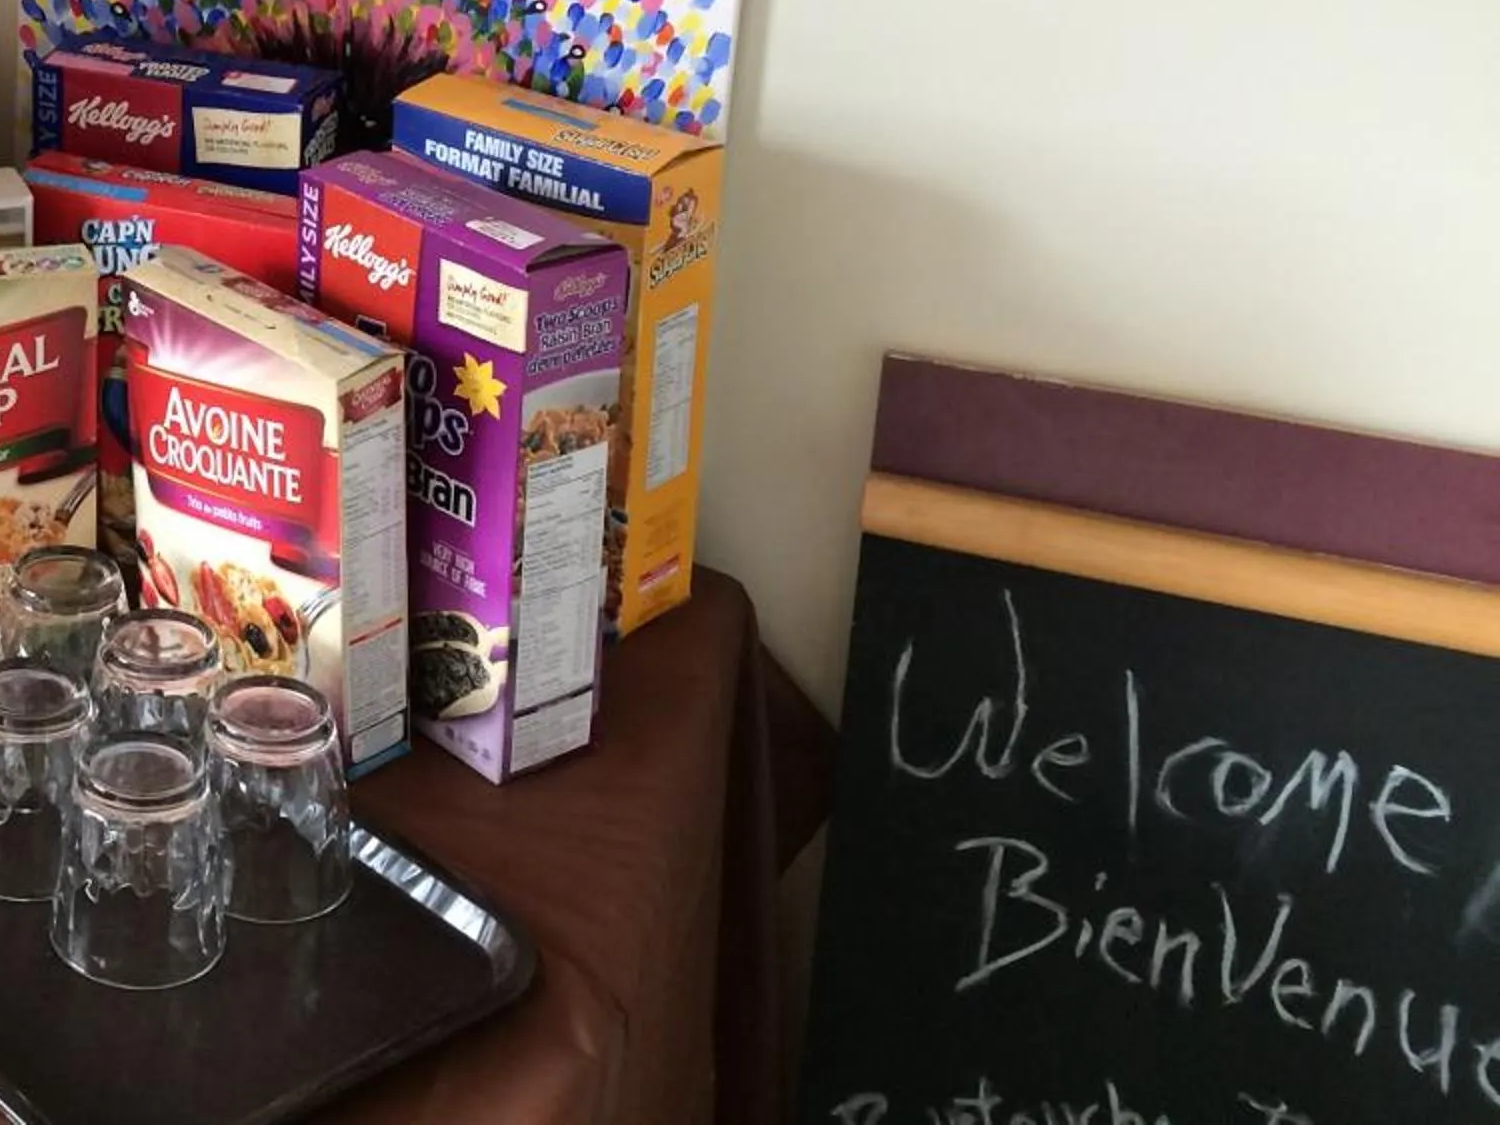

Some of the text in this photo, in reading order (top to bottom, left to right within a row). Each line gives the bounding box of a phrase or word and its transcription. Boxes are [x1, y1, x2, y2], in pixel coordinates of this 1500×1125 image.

[68, 96, 177, 146] Kellogg's
[465, 129, 524, 165] FAMILY
[527, 151, 564, 177] SIZE
[425, 138, 503, 184] FORMAT
[508, 165, 604, 211] FAMILIAL
[301, 183, 319, 245] SIZE
[323, 223, 416, 291] Kellogg's
[163, 386, 286, 461] AVOINE
[149, 427, 302, 505] CROQUANTE
[891, 588, 1452, 875] Welcome
